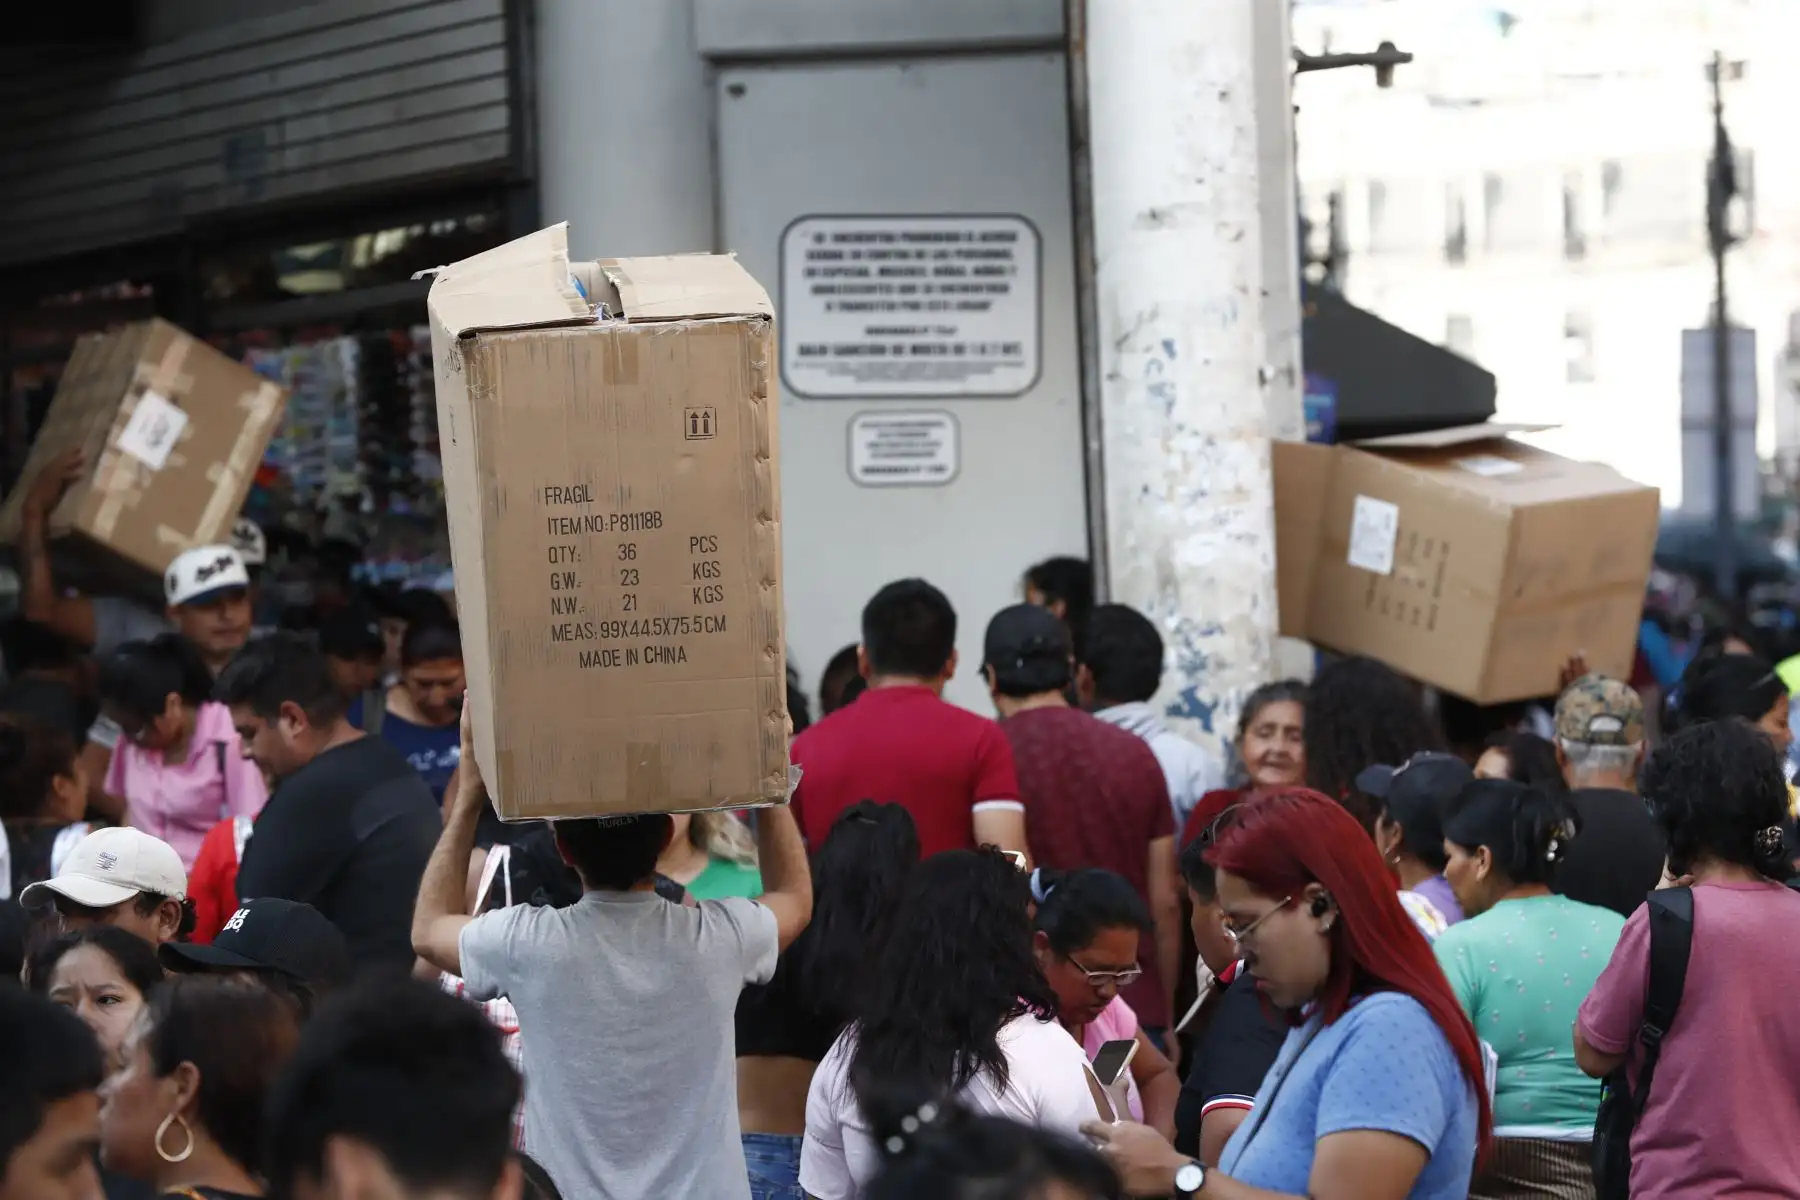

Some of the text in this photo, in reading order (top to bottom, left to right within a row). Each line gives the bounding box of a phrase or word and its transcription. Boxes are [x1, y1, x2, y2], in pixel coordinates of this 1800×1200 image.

[544, 485, 594, 506] FRAGIL
[547, 517, 582, 535] ITEM
[548, 535, 718, 564] QTY: 36 PCS
[620, 568, 640, 586] 23
[692, 561, 721, 580] KGS
[622, 593, 638, 611] 21
[692, 585, 724, 605] KGS
[579, 645, 688, 669] MADE IN CHINA
